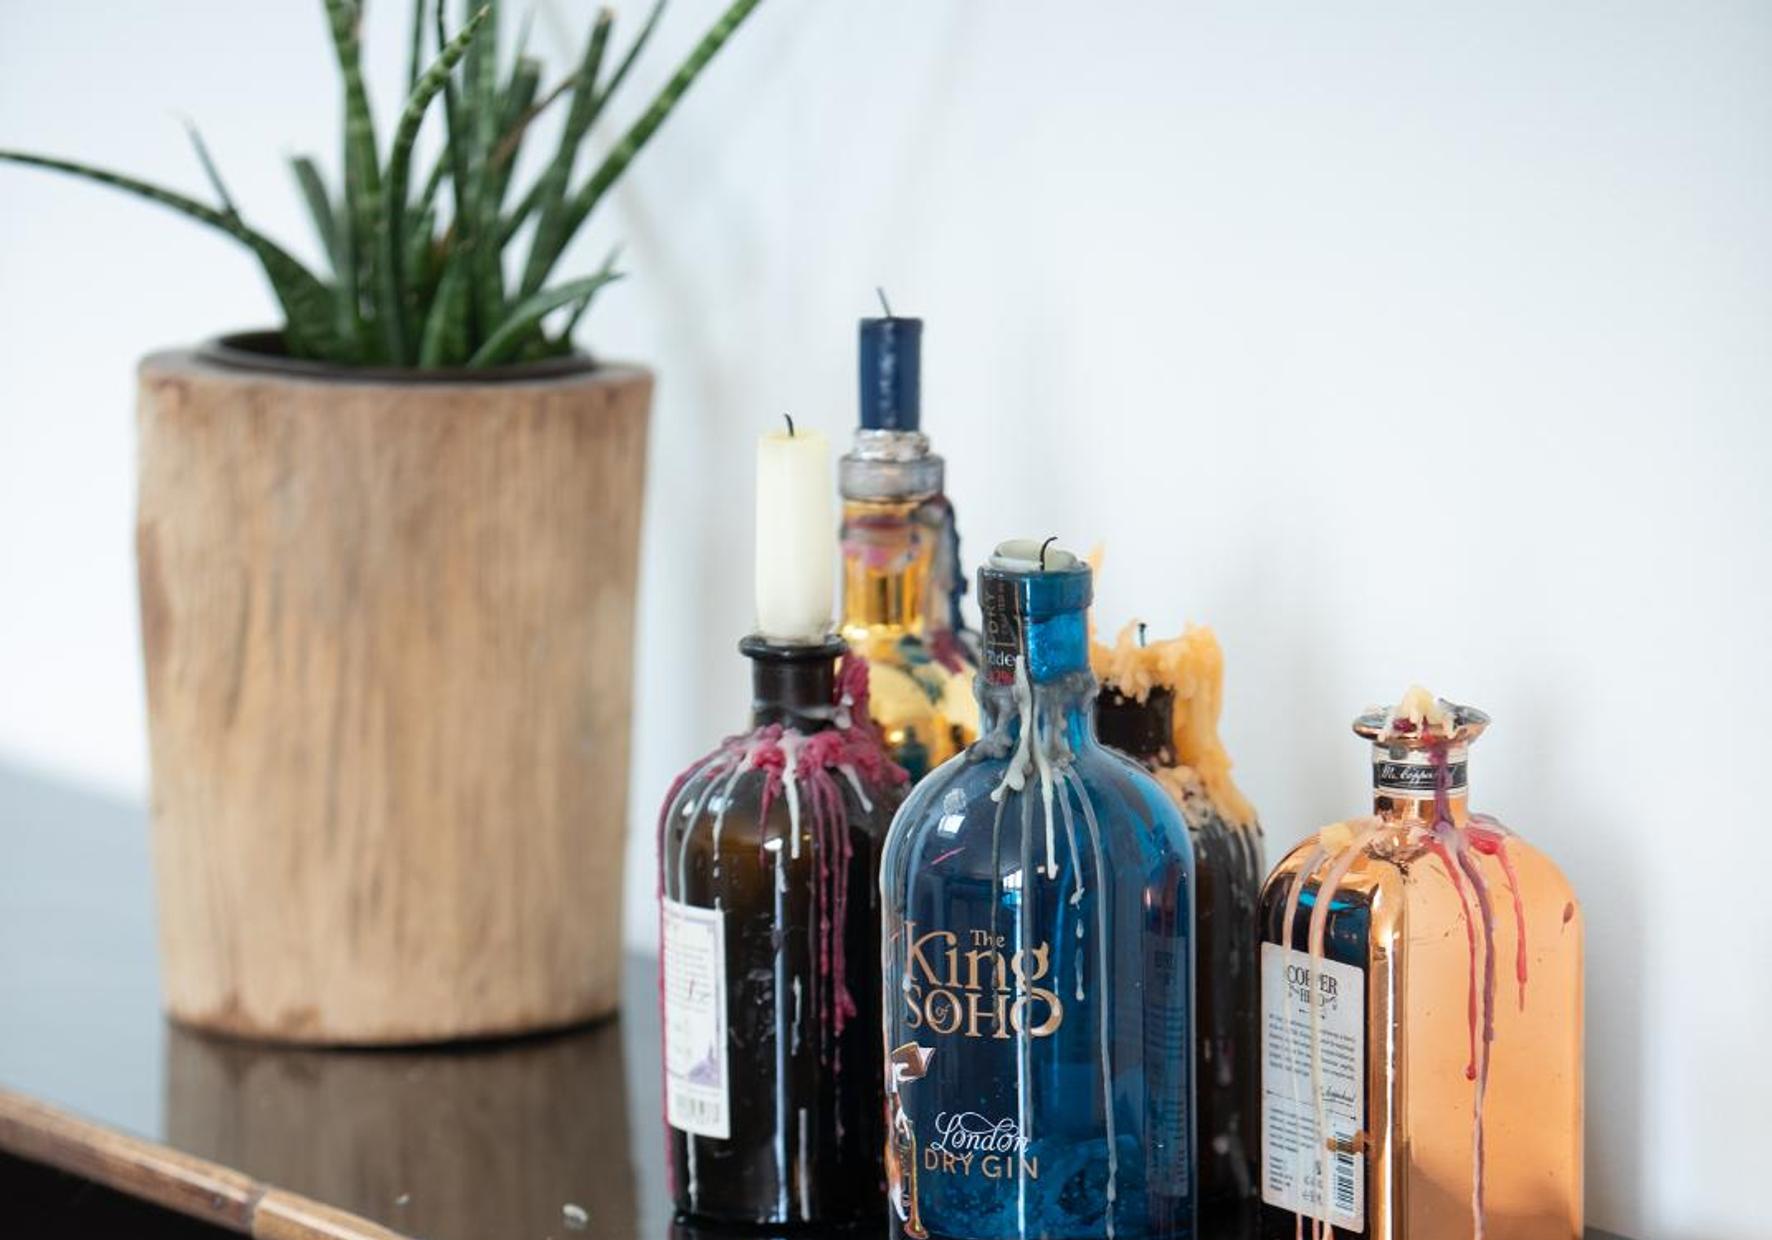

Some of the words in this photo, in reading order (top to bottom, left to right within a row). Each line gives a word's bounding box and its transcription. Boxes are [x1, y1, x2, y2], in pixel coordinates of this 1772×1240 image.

[904, 919, 1049, 991] King
[970, 929, 1006, 948] The
[1287, 964, 1338, 995] COER
[903, 985, 1063, 1039] SOHO
[930, 1111, 1029, 1158] London
[924, 1147, 974, 1176] DRY
[981, 1154, 1039, 1180] GIN
